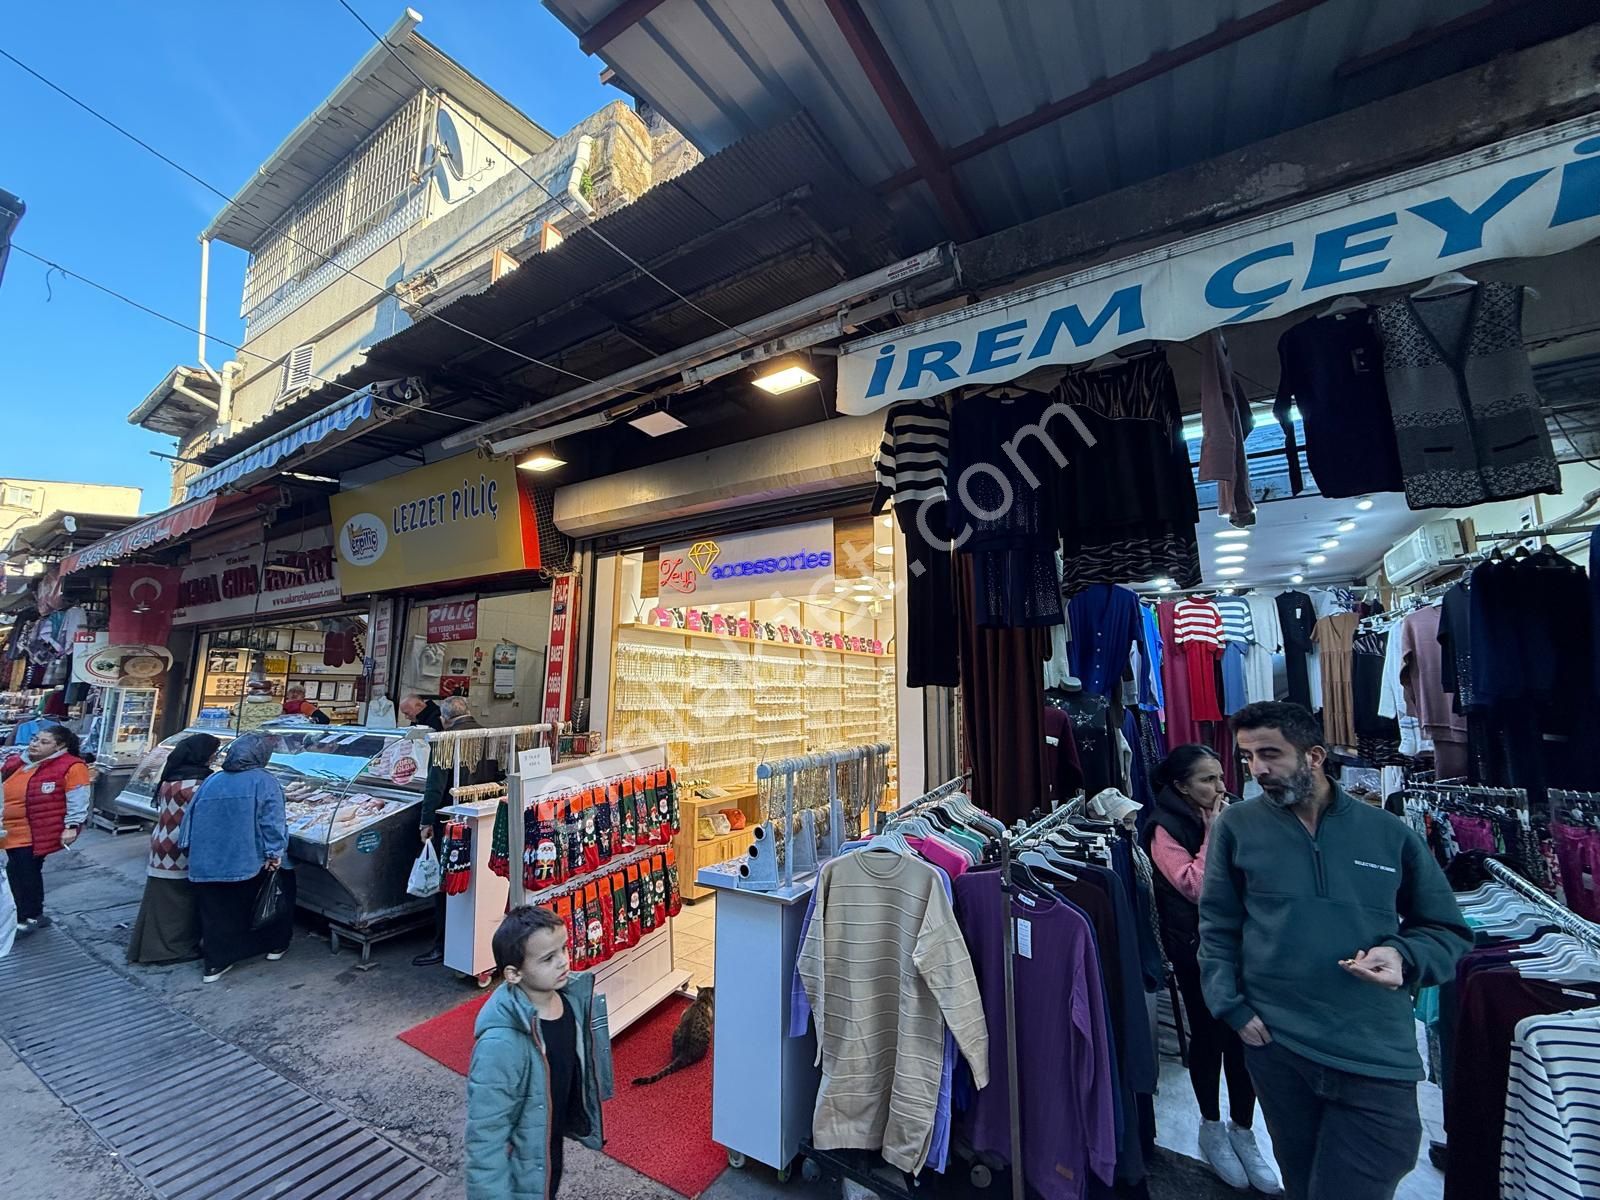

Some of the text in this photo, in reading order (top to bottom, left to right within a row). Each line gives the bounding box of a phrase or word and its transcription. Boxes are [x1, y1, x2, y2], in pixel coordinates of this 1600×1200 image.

[865, 285, 1146, 399] İREM
[393, 474, 498, 535] LEZZET PİLİÇ
[711, 549, 832, 581] accessories
[429, 602, 475, 623] PİLİÇ
[553, 614, 567, 631] BUT
